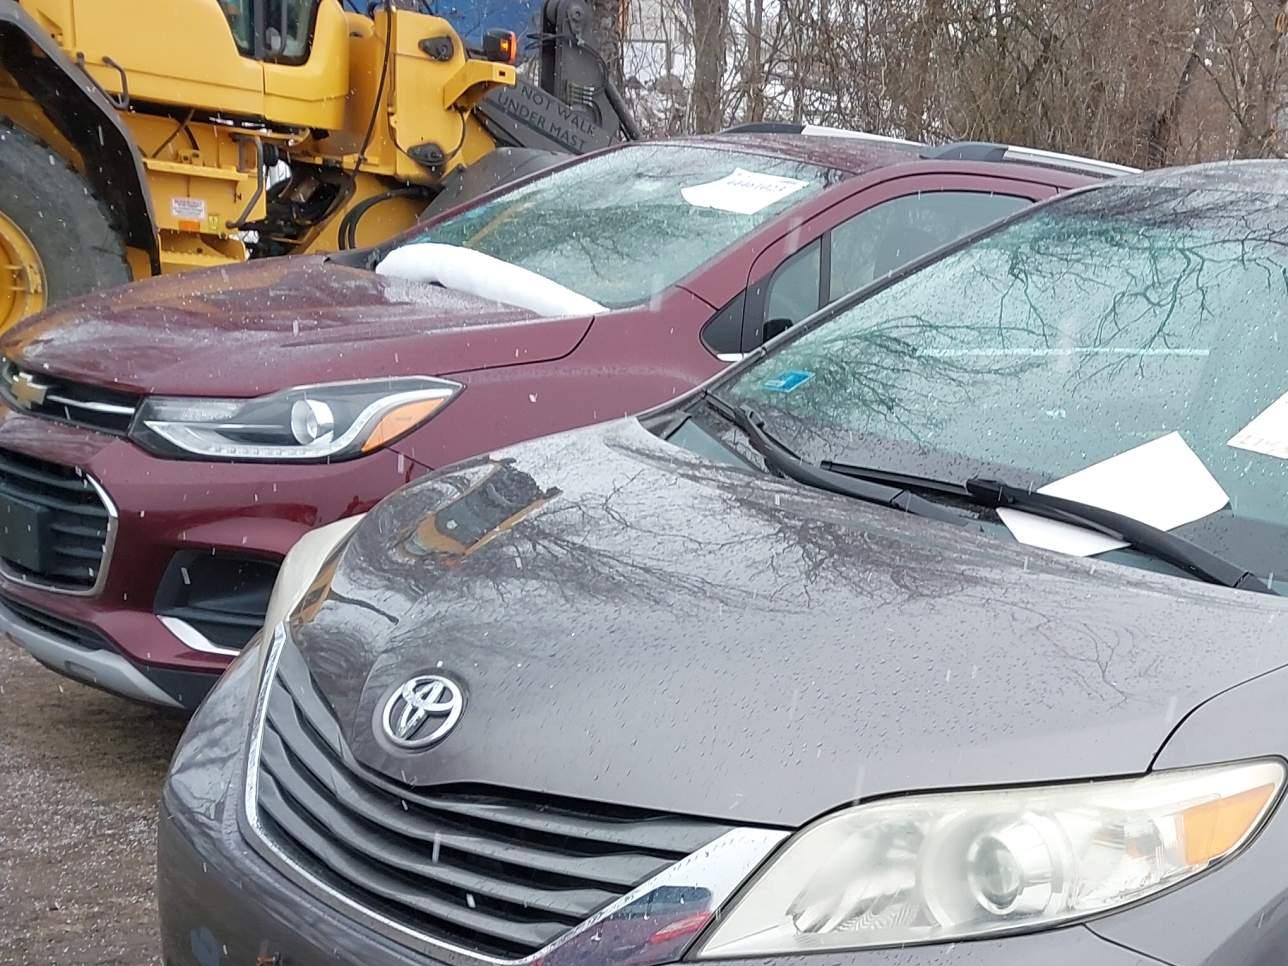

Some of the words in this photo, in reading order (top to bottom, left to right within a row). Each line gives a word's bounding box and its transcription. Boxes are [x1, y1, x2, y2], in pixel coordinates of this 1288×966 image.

[497, 91, 547, 128] UNDER
[551, 121, 586, 150] MAST
[521, 86, 551, 112] NOT
[558, 104, 596, 136] WALK
